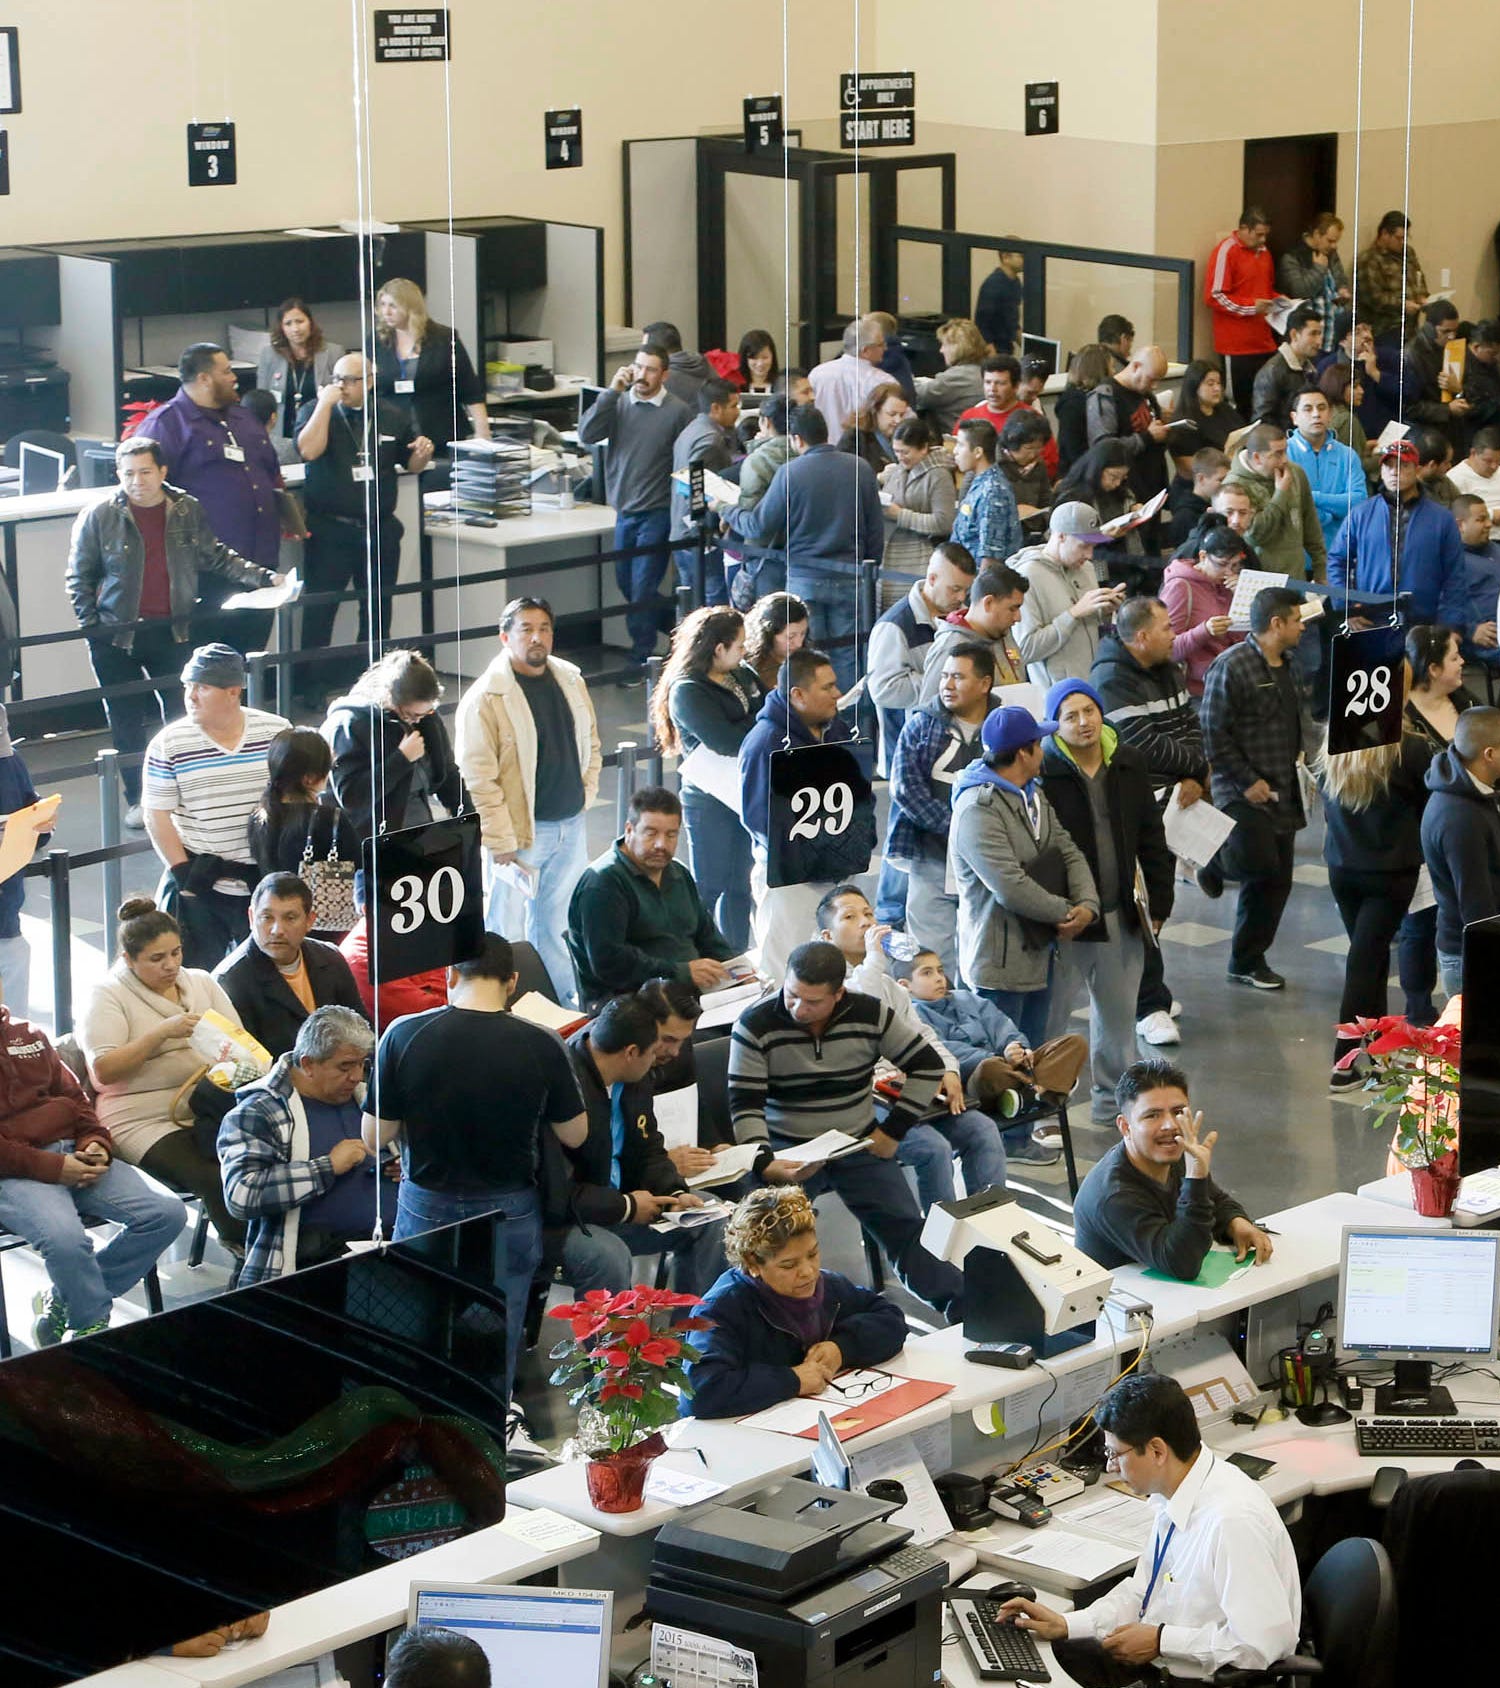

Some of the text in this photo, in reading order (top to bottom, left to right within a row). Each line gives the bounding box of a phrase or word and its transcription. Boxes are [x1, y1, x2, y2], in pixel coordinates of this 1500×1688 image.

[845, 118, 911, 141] START HERE
[1039, 109, 1047, 128] 6
[194, 140, 230, 150] WINDOW
[760, 125, 769, 146] 5
[560, 139, 570, 161] 4
[207, 154, 219, 178] 3
[1344, 665, 1391, 718] 28
[789, 782, 854, 842] 29
[390, 866, 465, 934] 30
[658, 1629, 683, 1645] 2015
